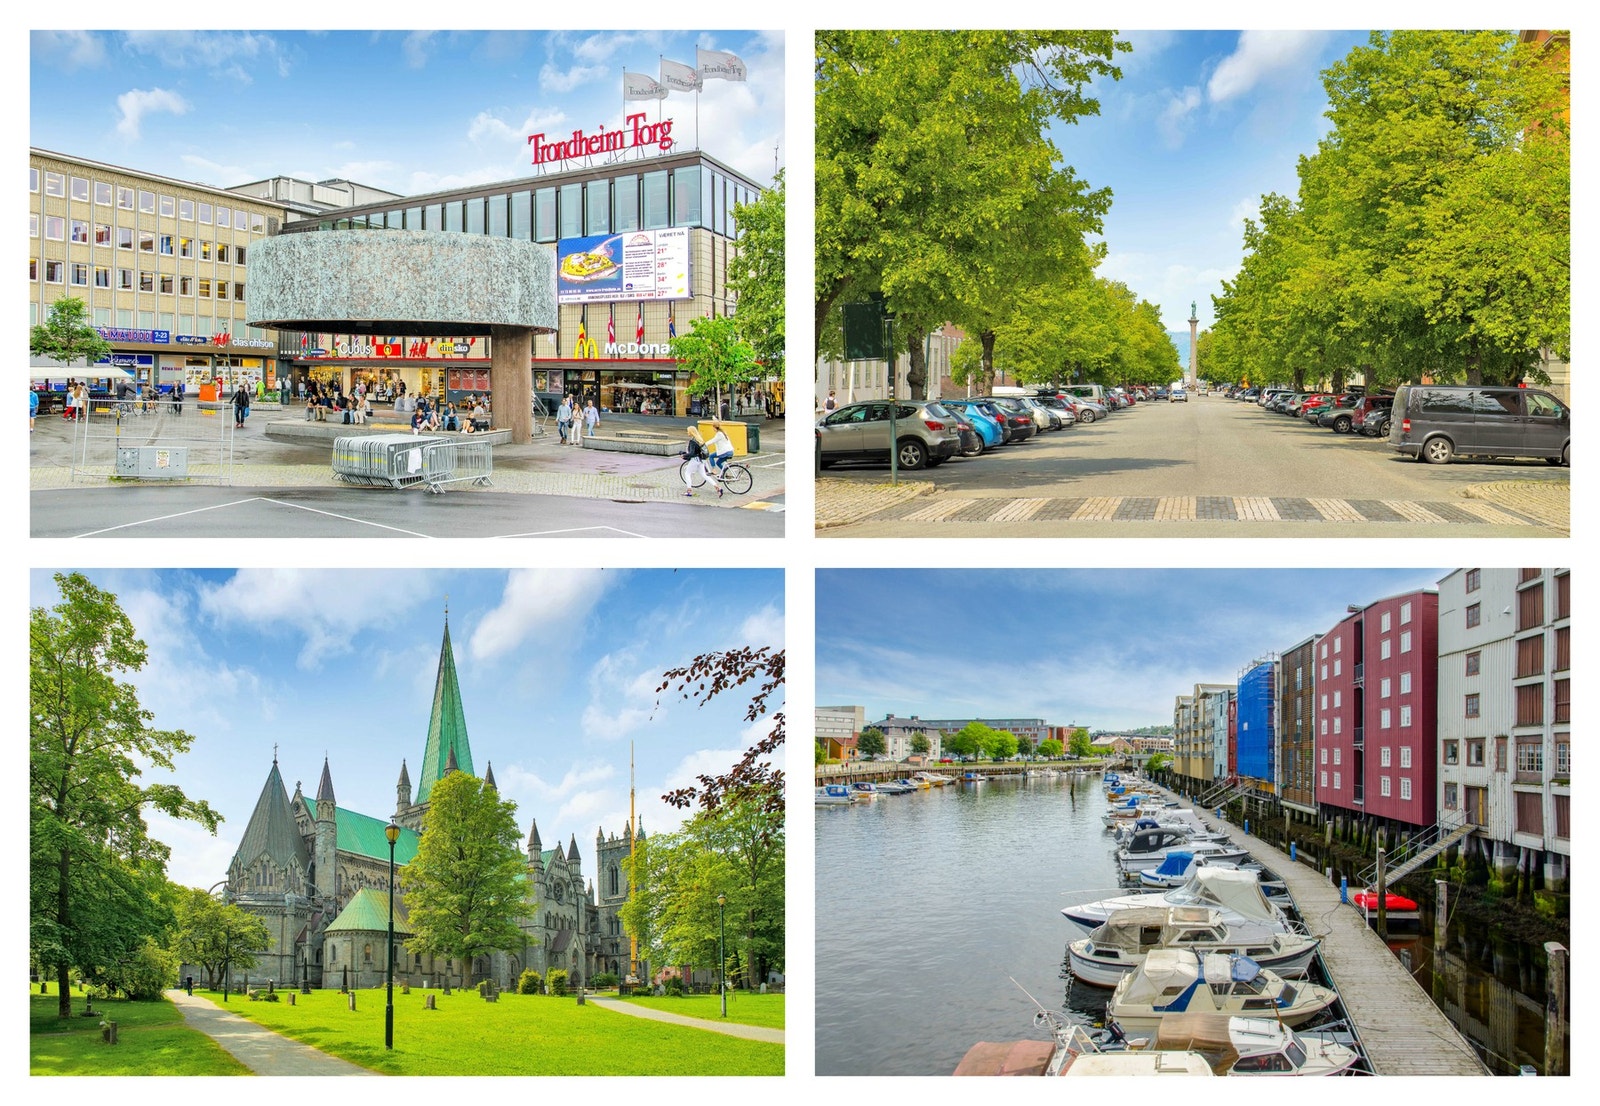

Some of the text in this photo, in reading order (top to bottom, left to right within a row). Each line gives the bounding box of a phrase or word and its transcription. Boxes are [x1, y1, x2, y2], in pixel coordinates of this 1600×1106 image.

[528, 112, 673, 165] Trondheim Torg
[128, 330, 150, 340] 1000
[232, 337, 274, 348] clas ohlson
[439, 343, 454, 352] din
[604, 342, 674, 355] McDona
[339, 343, 373, 355] Cubus
[409, 342, 429, 357] H&M
